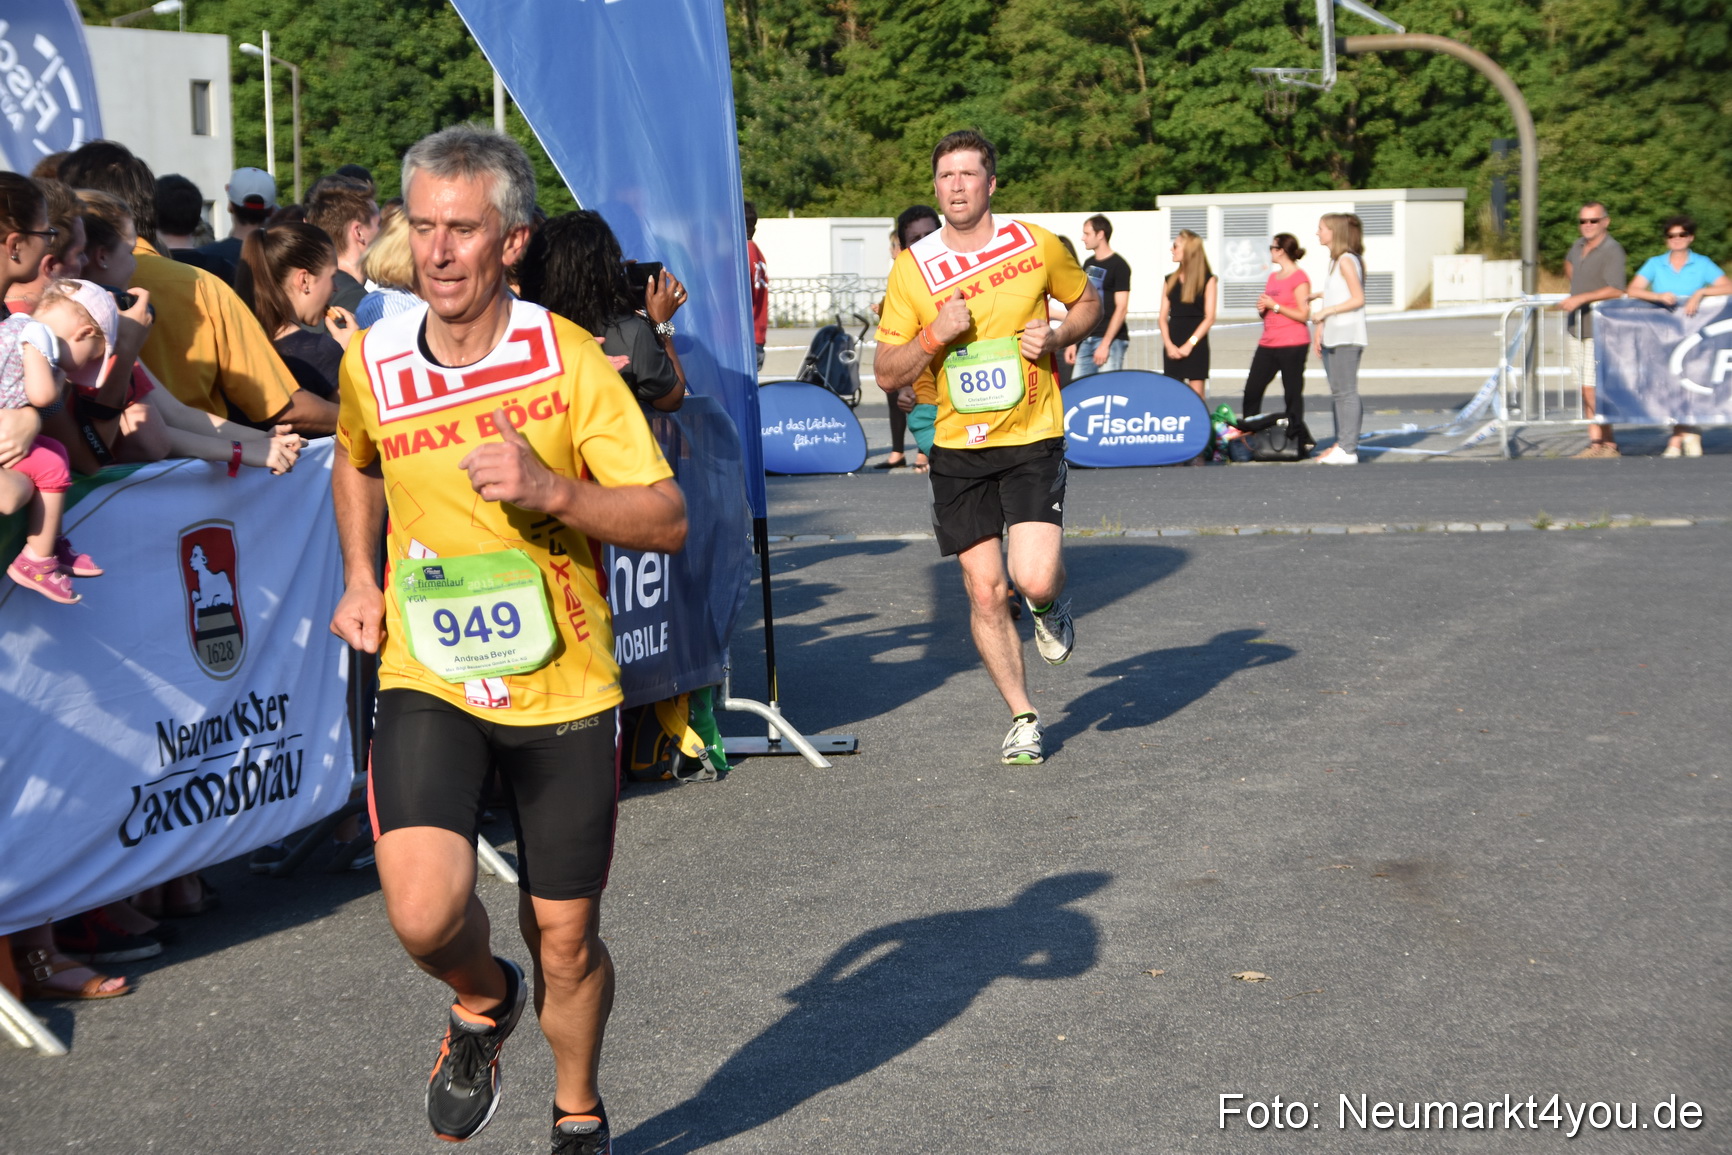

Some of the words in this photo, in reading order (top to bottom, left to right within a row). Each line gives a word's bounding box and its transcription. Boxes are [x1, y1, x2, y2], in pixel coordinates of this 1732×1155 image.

[988, 255, 1043, 288] BÖGL
[959, 367, 1006, 394] 880
[381, 420, 466, 461] MAX
[475, 391, 569, 438] BÖGL
[761, 420, 783, 435] und
[786, 418, 805, 431] das
[1087, 411, 1191, 435] Fischer
[83, 424, 105, 455] SONY
[793, 433, 821, 451] fährt
[823, 432, 847, 444] mit!
[1098, 433, 1185, 446] AUTOMOBILE
[418, 576, 464, 588] firmenlauf
[433, 601, 521, 647] 949
[206, 640, 234, 664] 1628
[454, 653, 490, 663] Andreas
[490, 648, 516, 659] Beyer
[570, 716, 600, 731] asics
